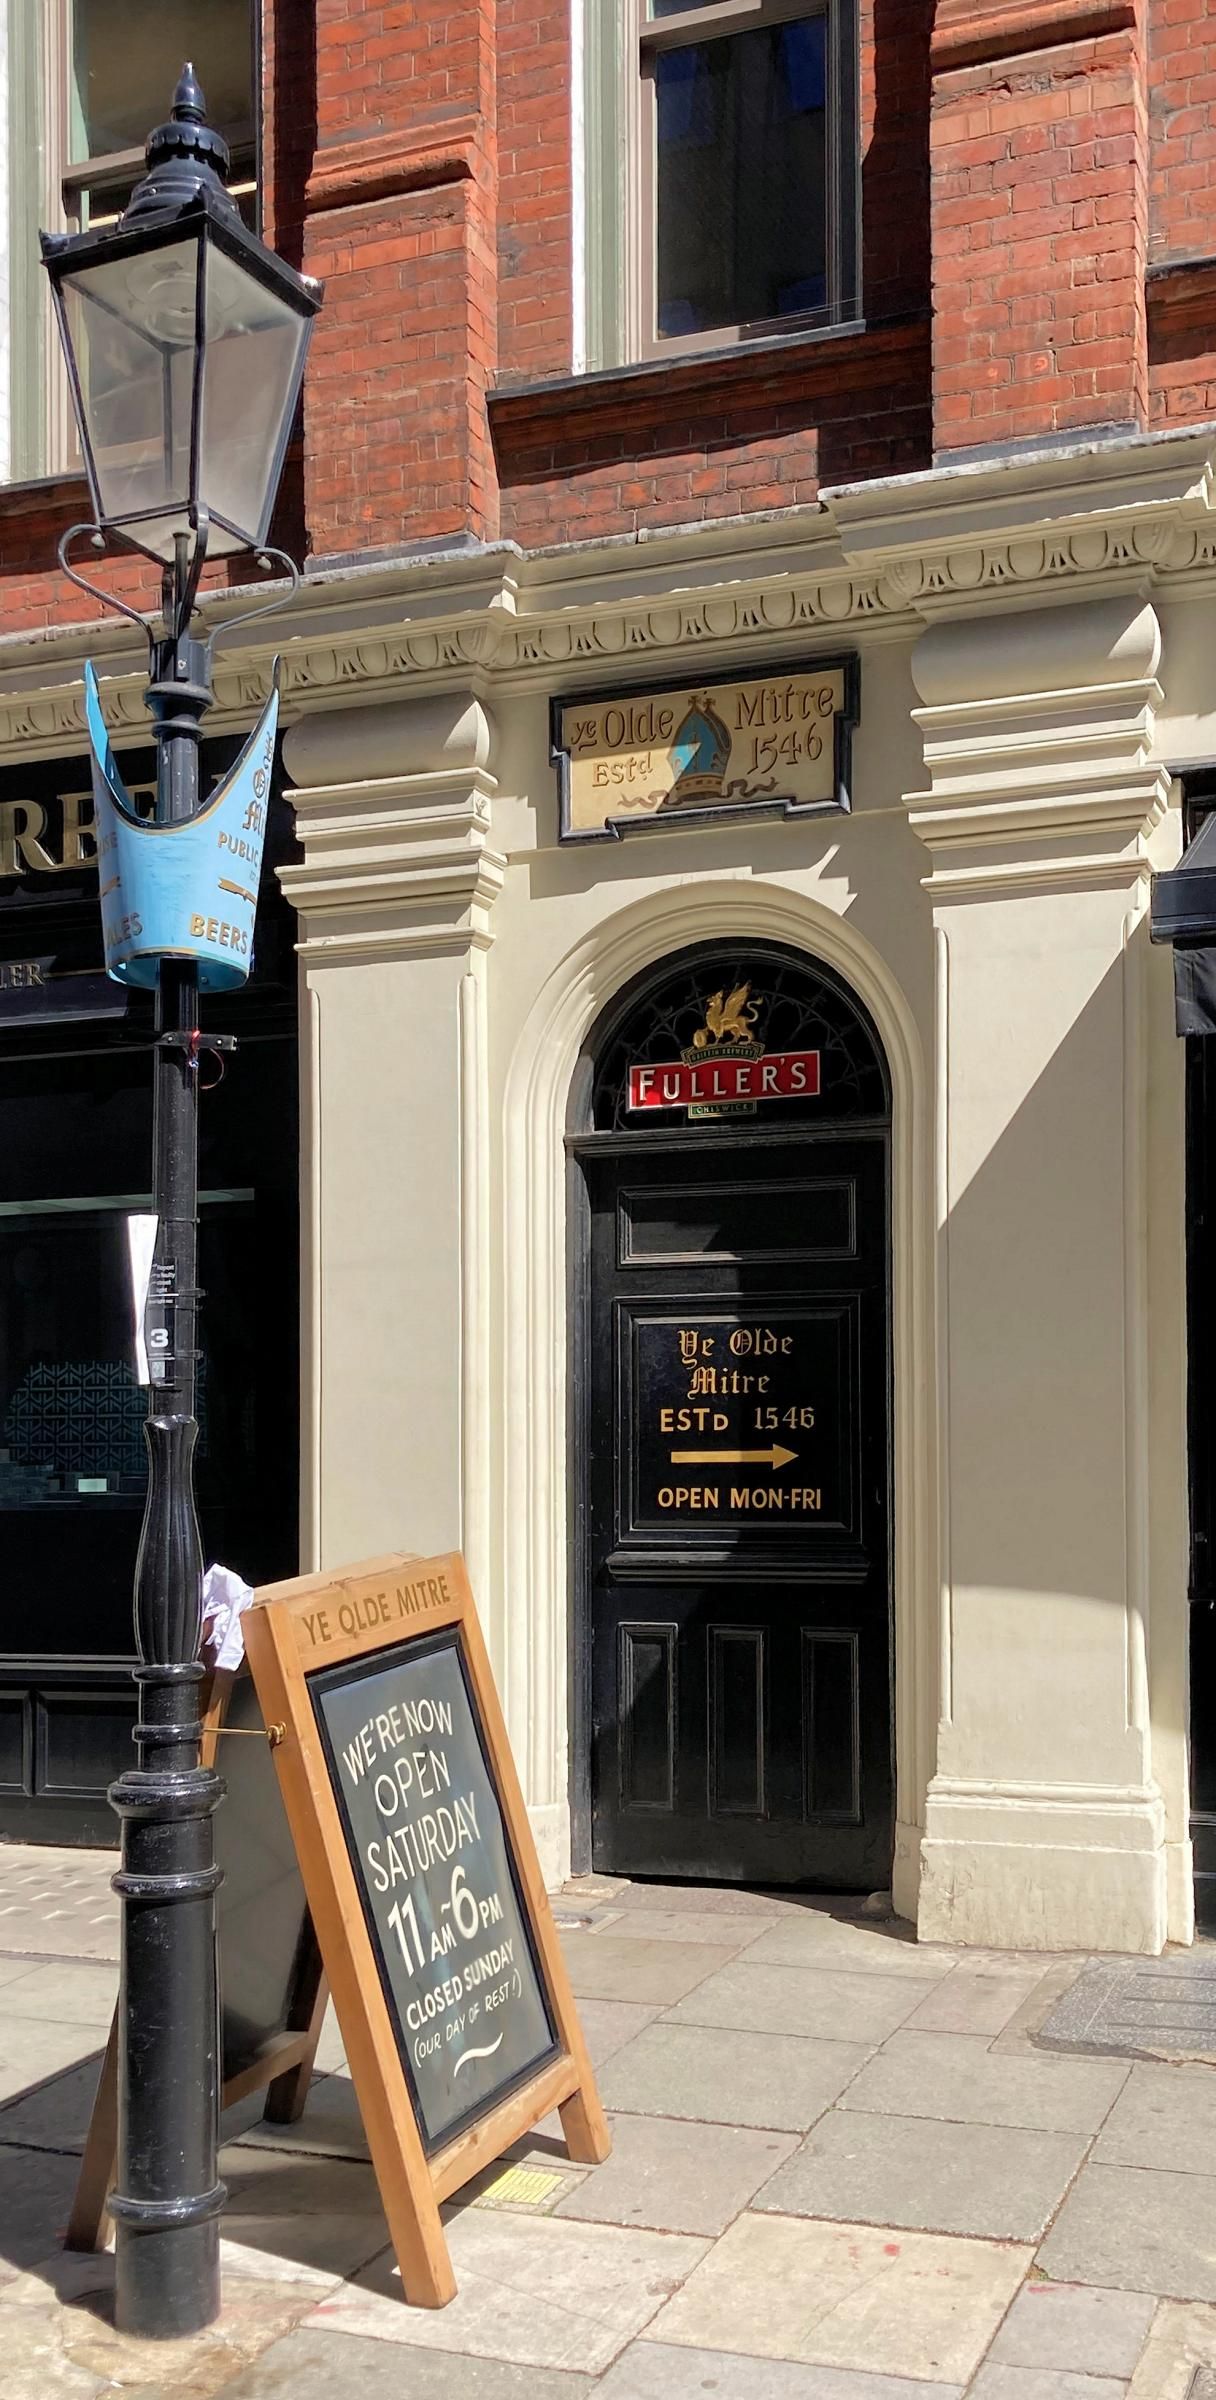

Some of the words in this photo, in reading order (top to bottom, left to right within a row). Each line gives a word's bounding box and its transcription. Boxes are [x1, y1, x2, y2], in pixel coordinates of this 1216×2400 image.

[570, 718, 597, 750] ye
[604, 703, 675, 748] Olde
[734, 683, 834, 731] Mitre
[592, 751, 653, 788] Estd
[747, 723, 823, 775] 1546
[218, 831, 259, 868] PUBLIC
[190, 911, 248, 955] BEERS
[639, 1058, 807, 1101] FULLER'S
[696, 1103, 749, 1115] CHISWICK
[150, 1328, 169, 1348] 3
[678, 1330, 715, 1369] Ye
[729, 1328, 794, 1356] Olde
[687, 1366, 770, 1399] Mitre
[753, 1407, 815, 1430] 1546
[657, 1488, 719, 1509] OPEN
[730, 1488, 821, 1509] MON-FRI
[302, 1610, 332, 1646] YE
[338, 1593, 391, 1635] OLDE
[396, 1575, 451, 1617] MITRE
[343, 1703, 405, 1786] WE'RE
[402, 1699, 453, 1737] NOW
[374, 1750, 451, 1817] OPEN
[367, 1792, 481, 1892] SATURDAY
[406, 1975, 464, 2030] CLOSED
[464, 1938, 516, 1991] SUNDAY
[414, 2032, 442, 2068] (OUR
[445, 2015, 466, 2042] DAY
[468, 2002, 480, 2024] OF
